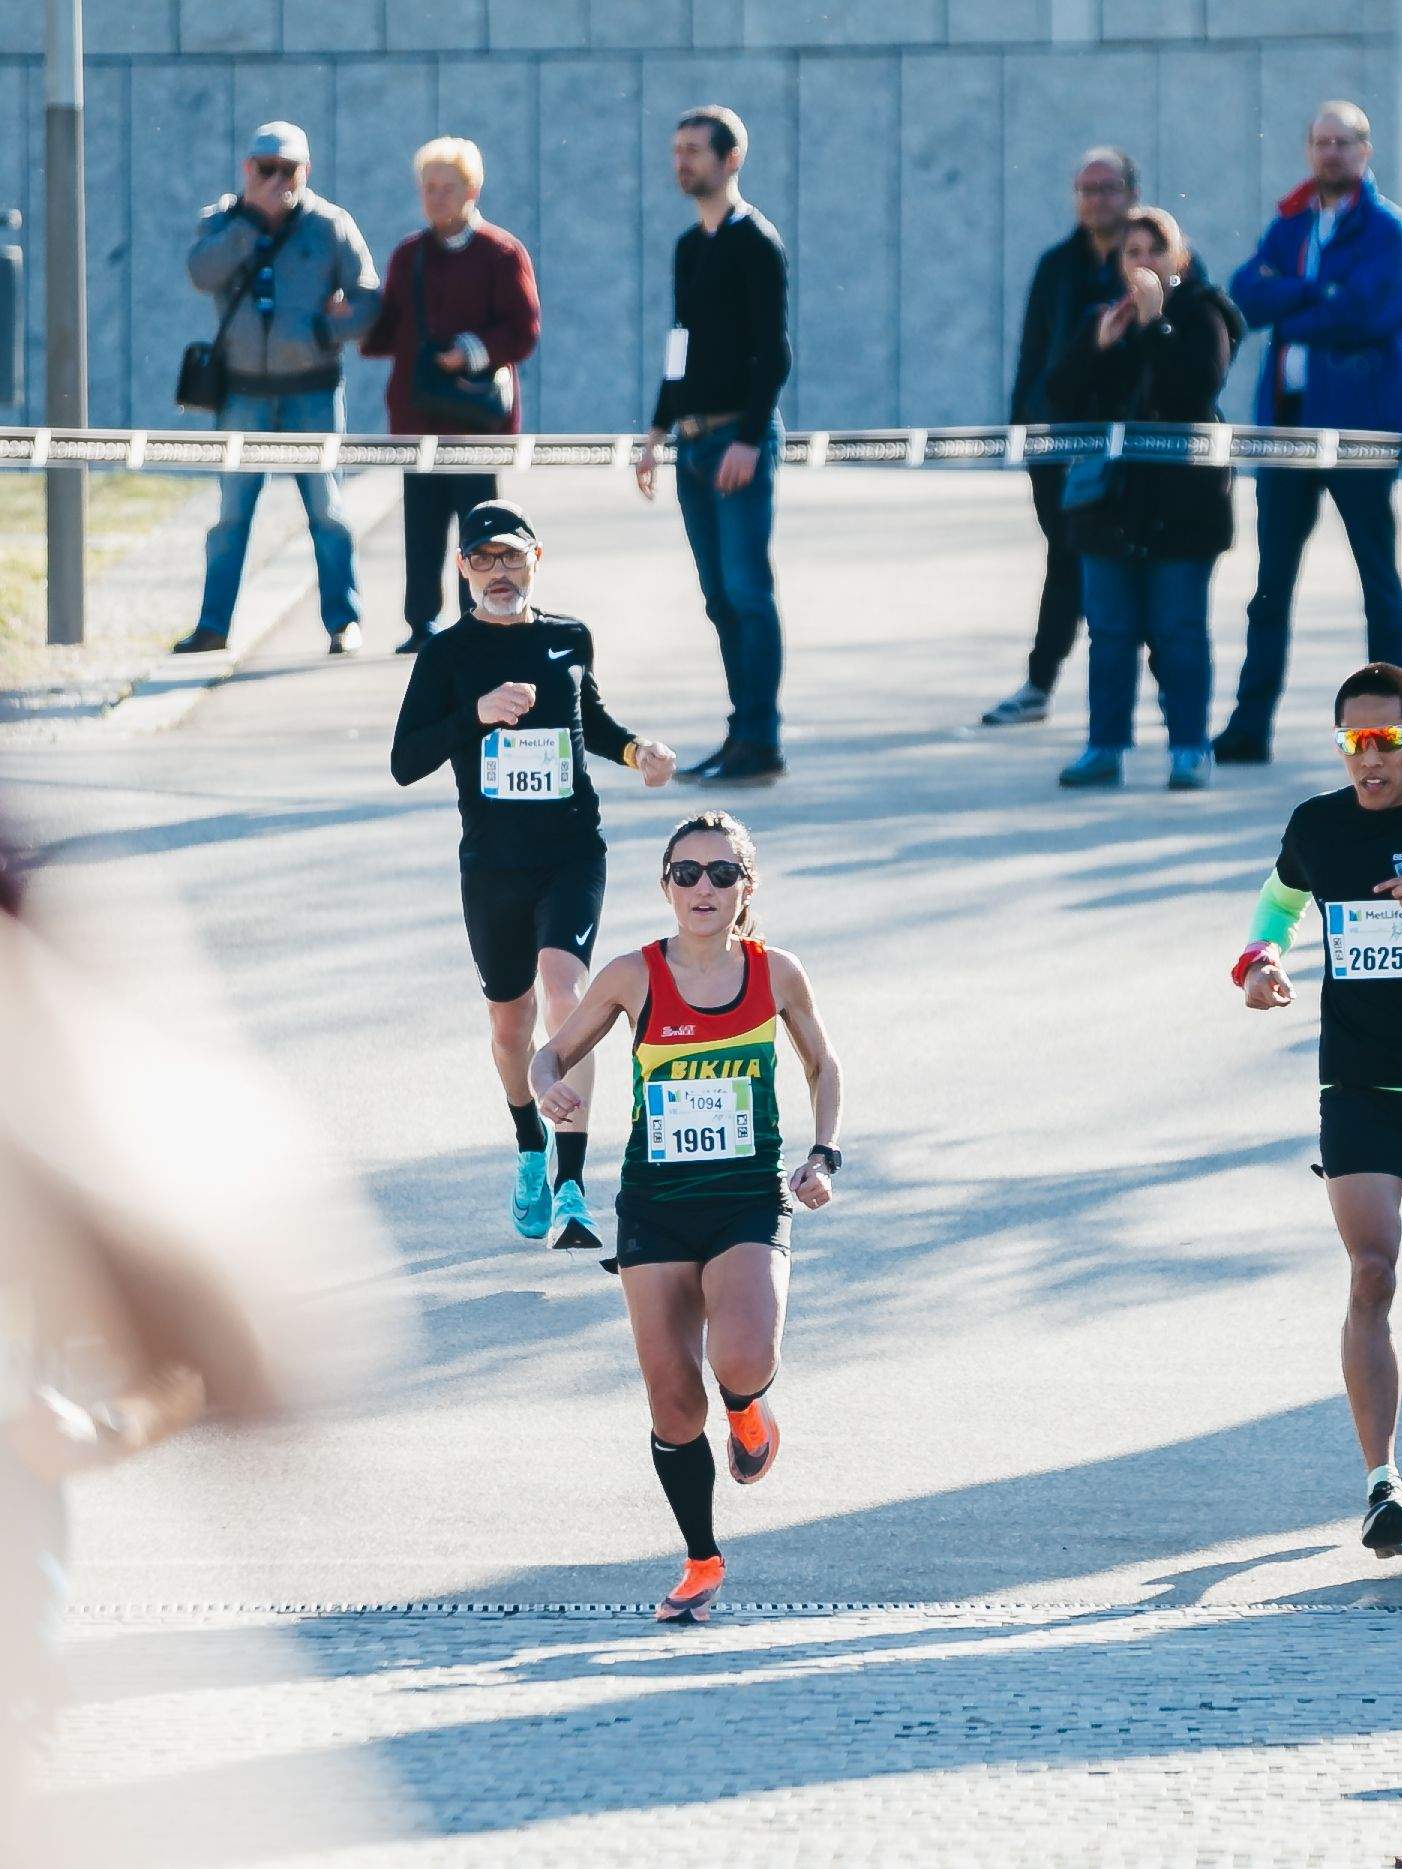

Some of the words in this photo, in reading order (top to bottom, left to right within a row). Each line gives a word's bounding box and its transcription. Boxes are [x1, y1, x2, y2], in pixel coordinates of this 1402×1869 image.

[519, 737, 555, 748] MetLife
[506, 771, 553, 792] 1851
[689, 1096, 723, 1110] 1094
[672, 1126, 727, 1154] 1961
